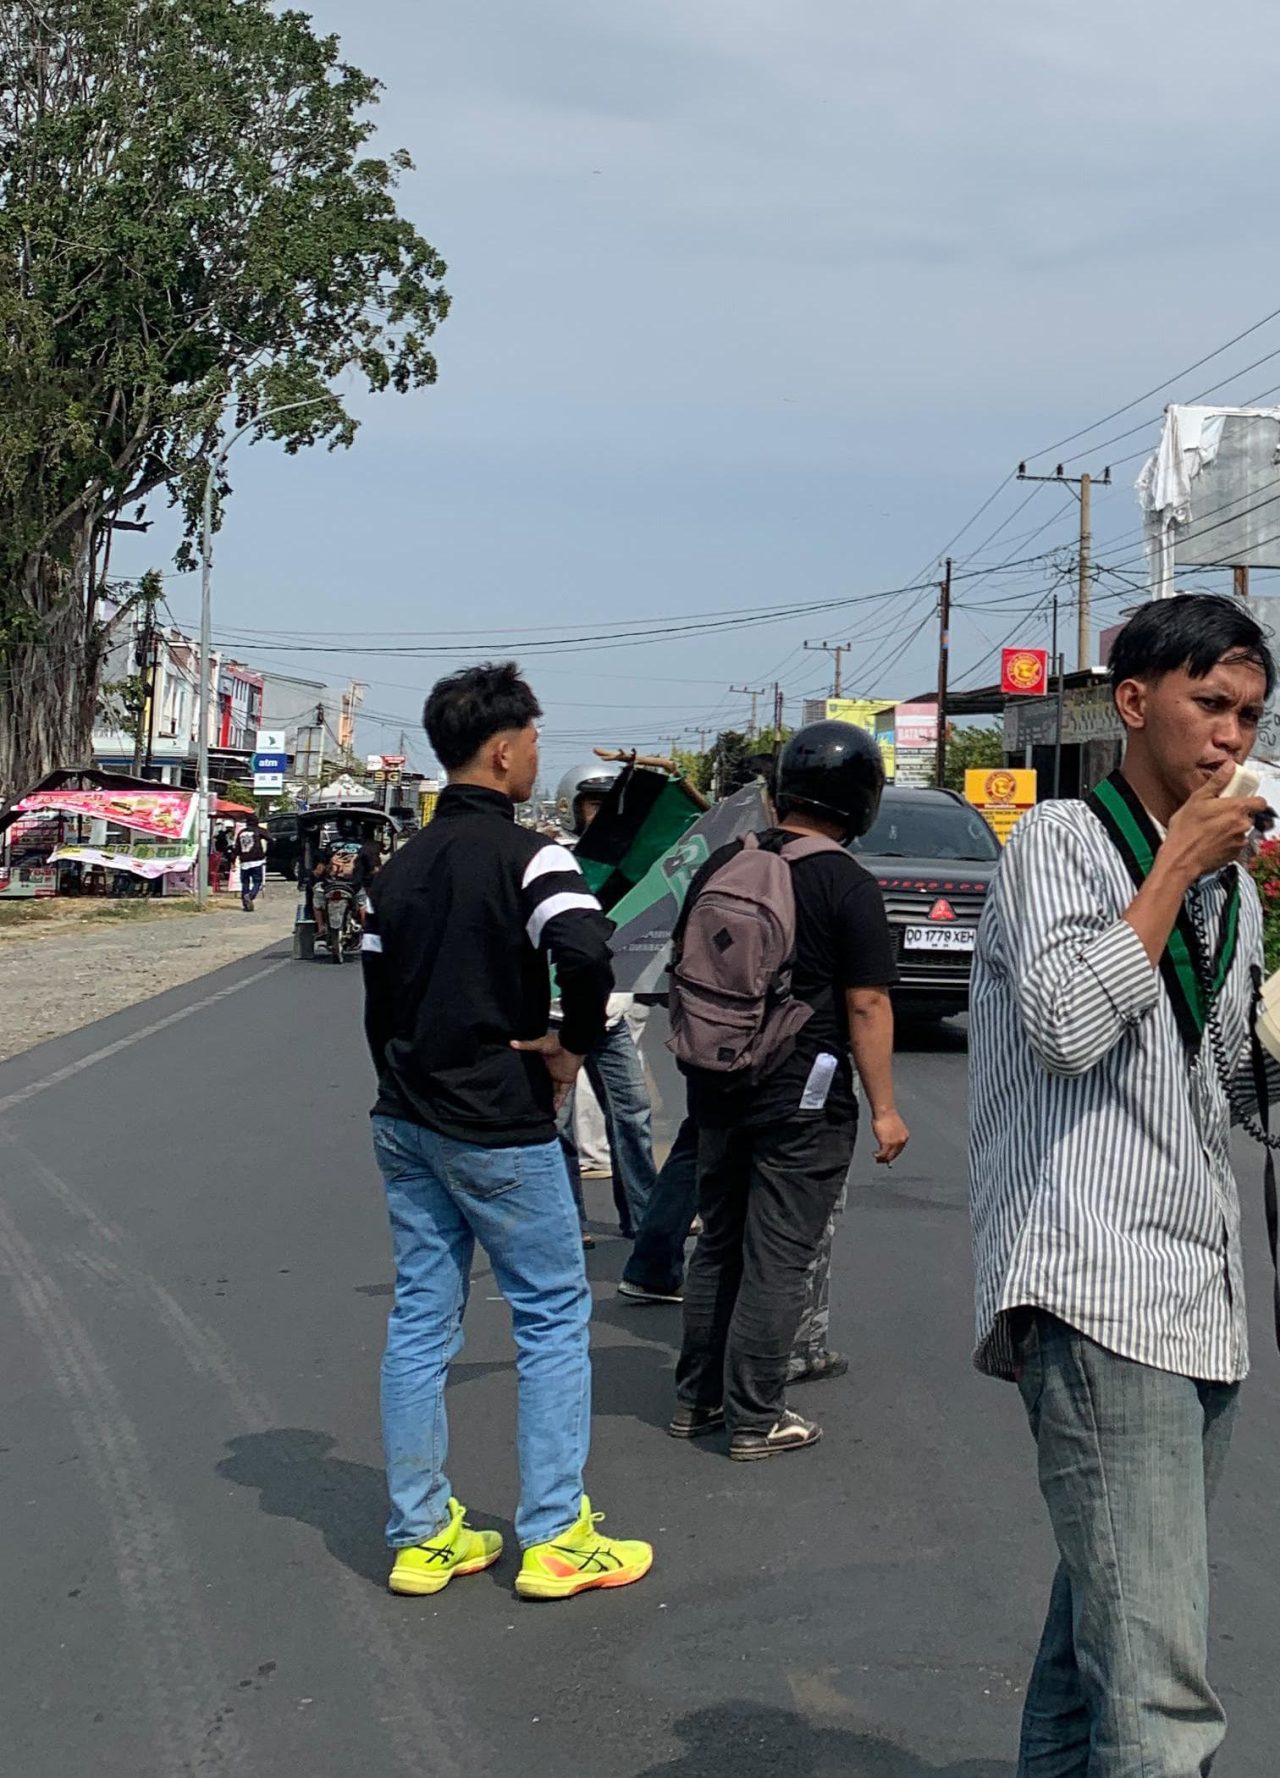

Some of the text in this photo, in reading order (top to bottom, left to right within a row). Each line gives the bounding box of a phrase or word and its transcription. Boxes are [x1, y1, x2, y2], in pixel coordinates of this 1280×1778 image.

[258, 758, 278, 767] atm
[906, 929, 975, 943] DD 1779 XEH
